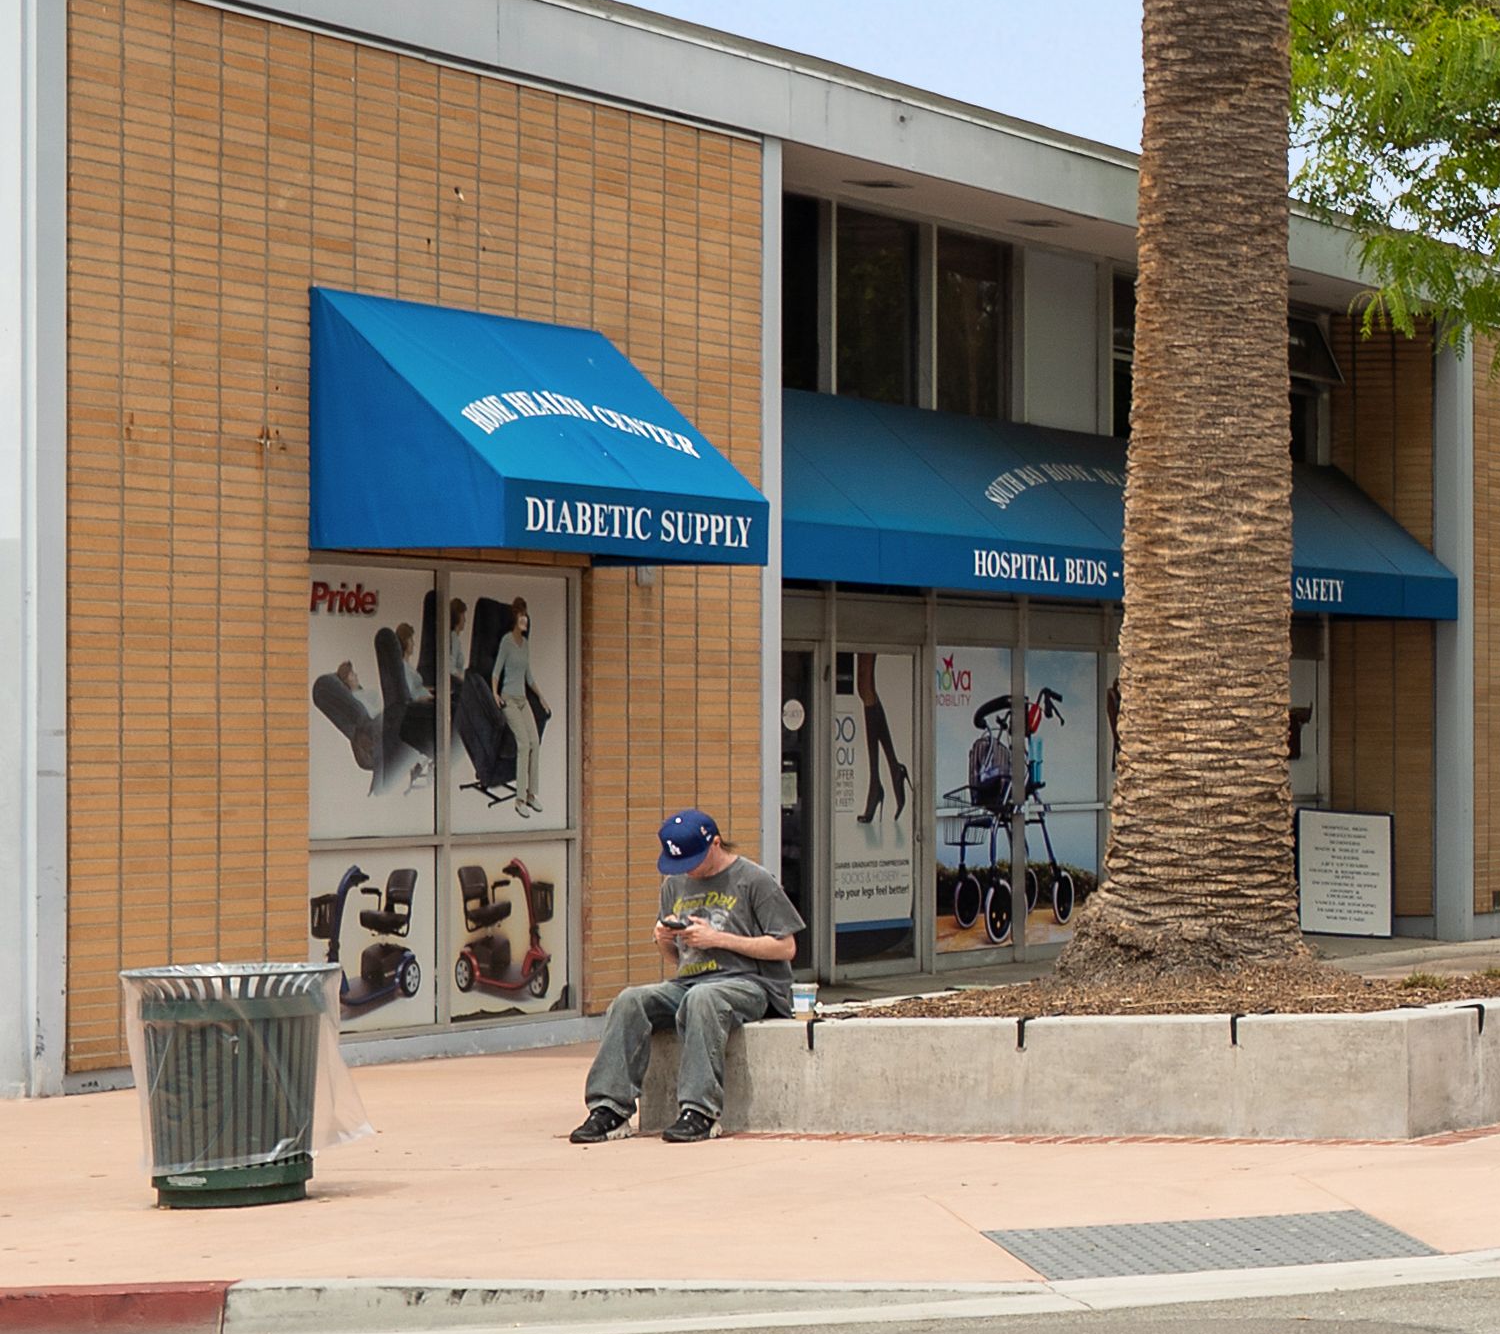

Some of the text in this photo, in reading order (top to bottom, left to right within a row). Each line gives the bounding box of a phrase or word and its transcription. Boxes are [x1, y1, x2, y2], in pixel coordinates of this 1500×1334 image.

[461, 390, 700, 459] HOME HEALTH CENTER
[985, 472, 1026, 509] SOUTH
[525, 496, 752, 548] DIABETIC SUPPLY
[974, 550, 1059, 582] HOSPITAL
[1065, 558, 1107, 586] BEDS
[310, 581, 377, 614] Pride
[1295, 577, 1344, 603] SAFETY
[705, 890, 737, 910] Day
[846, 889, 860, 900] your
[862, 886, 874, 899] legs
[876, 885, 887, 895] feel
[888, 883, 909, 895] better!
